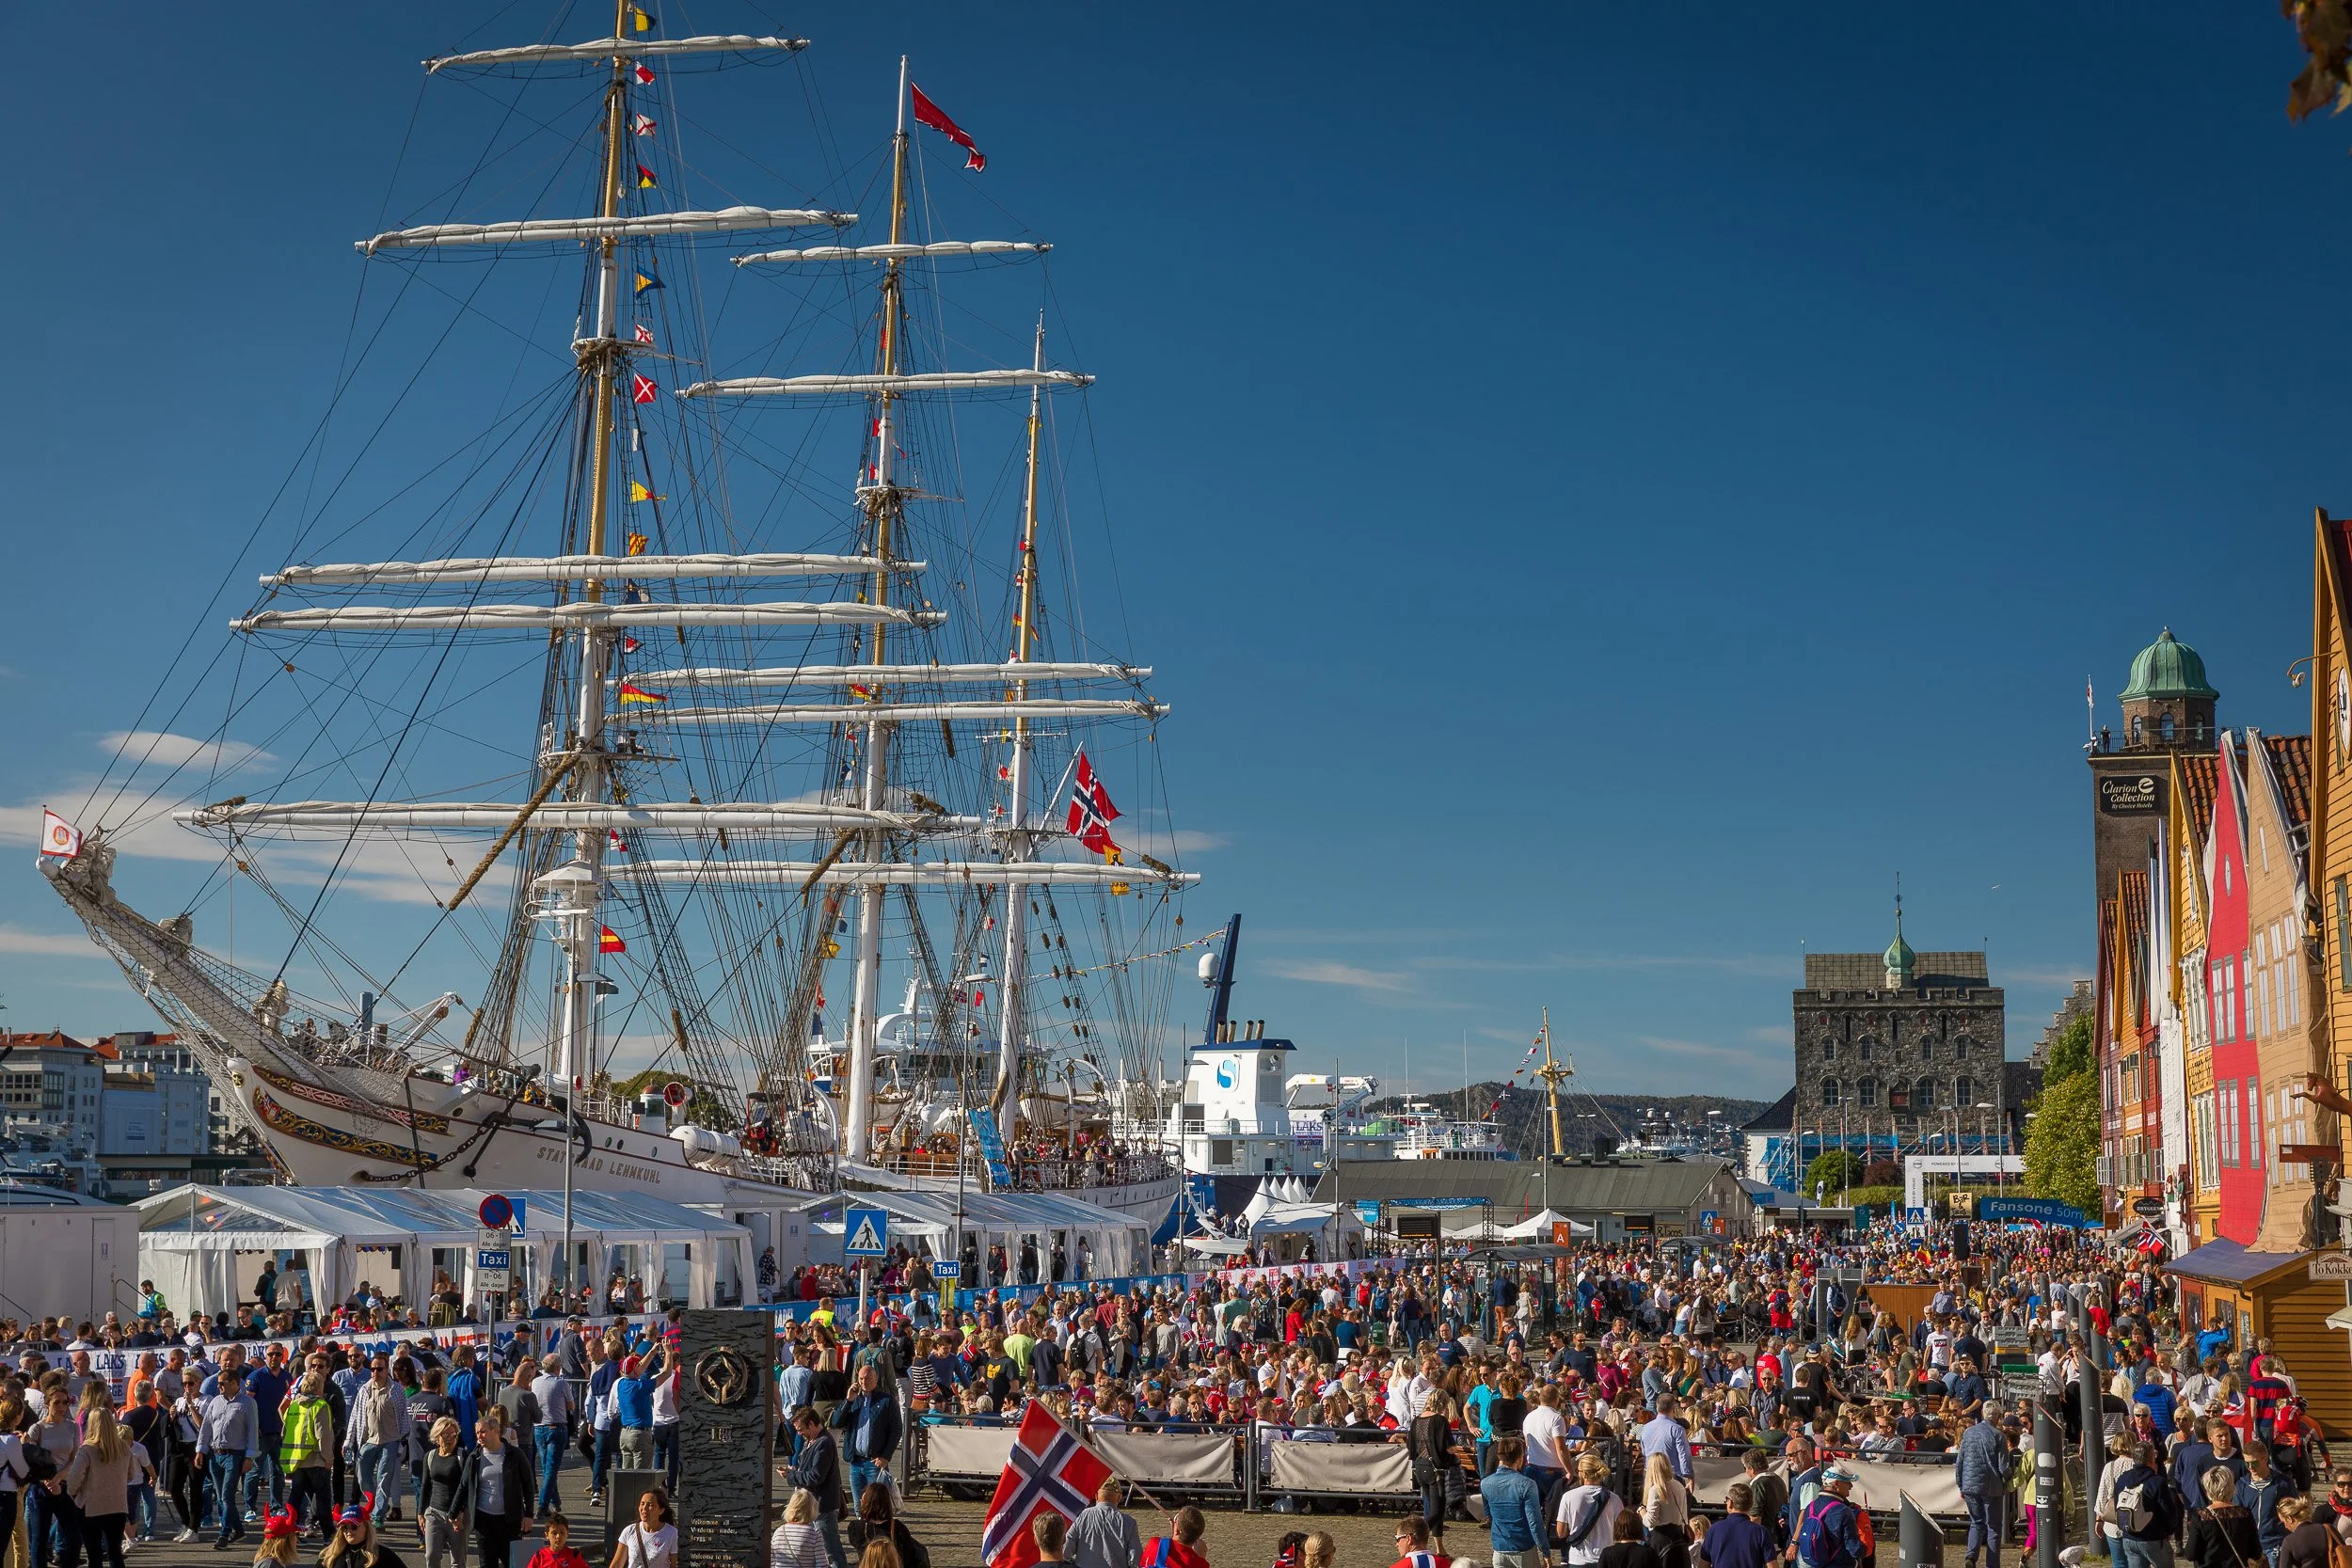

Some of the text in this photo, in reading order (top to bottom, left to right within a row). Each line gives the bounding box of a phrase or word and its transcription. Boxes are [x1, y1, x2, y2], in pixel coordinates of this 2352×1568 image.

[2103, 781, 2137, 794] Clarion
[2110, 793, 2154, 802] Collection
[609, 1162, 660, 1184] LEHMKUHL
[1990, 1201, 2082, 1220] Fansone 50m
[1556, 1233, 1565, 1243] A
[482, 1253, 506, 1264] Taxi
[937, 1264, 957, 1275] Taxi
[96, 1354, 125, 1370] LAKS
